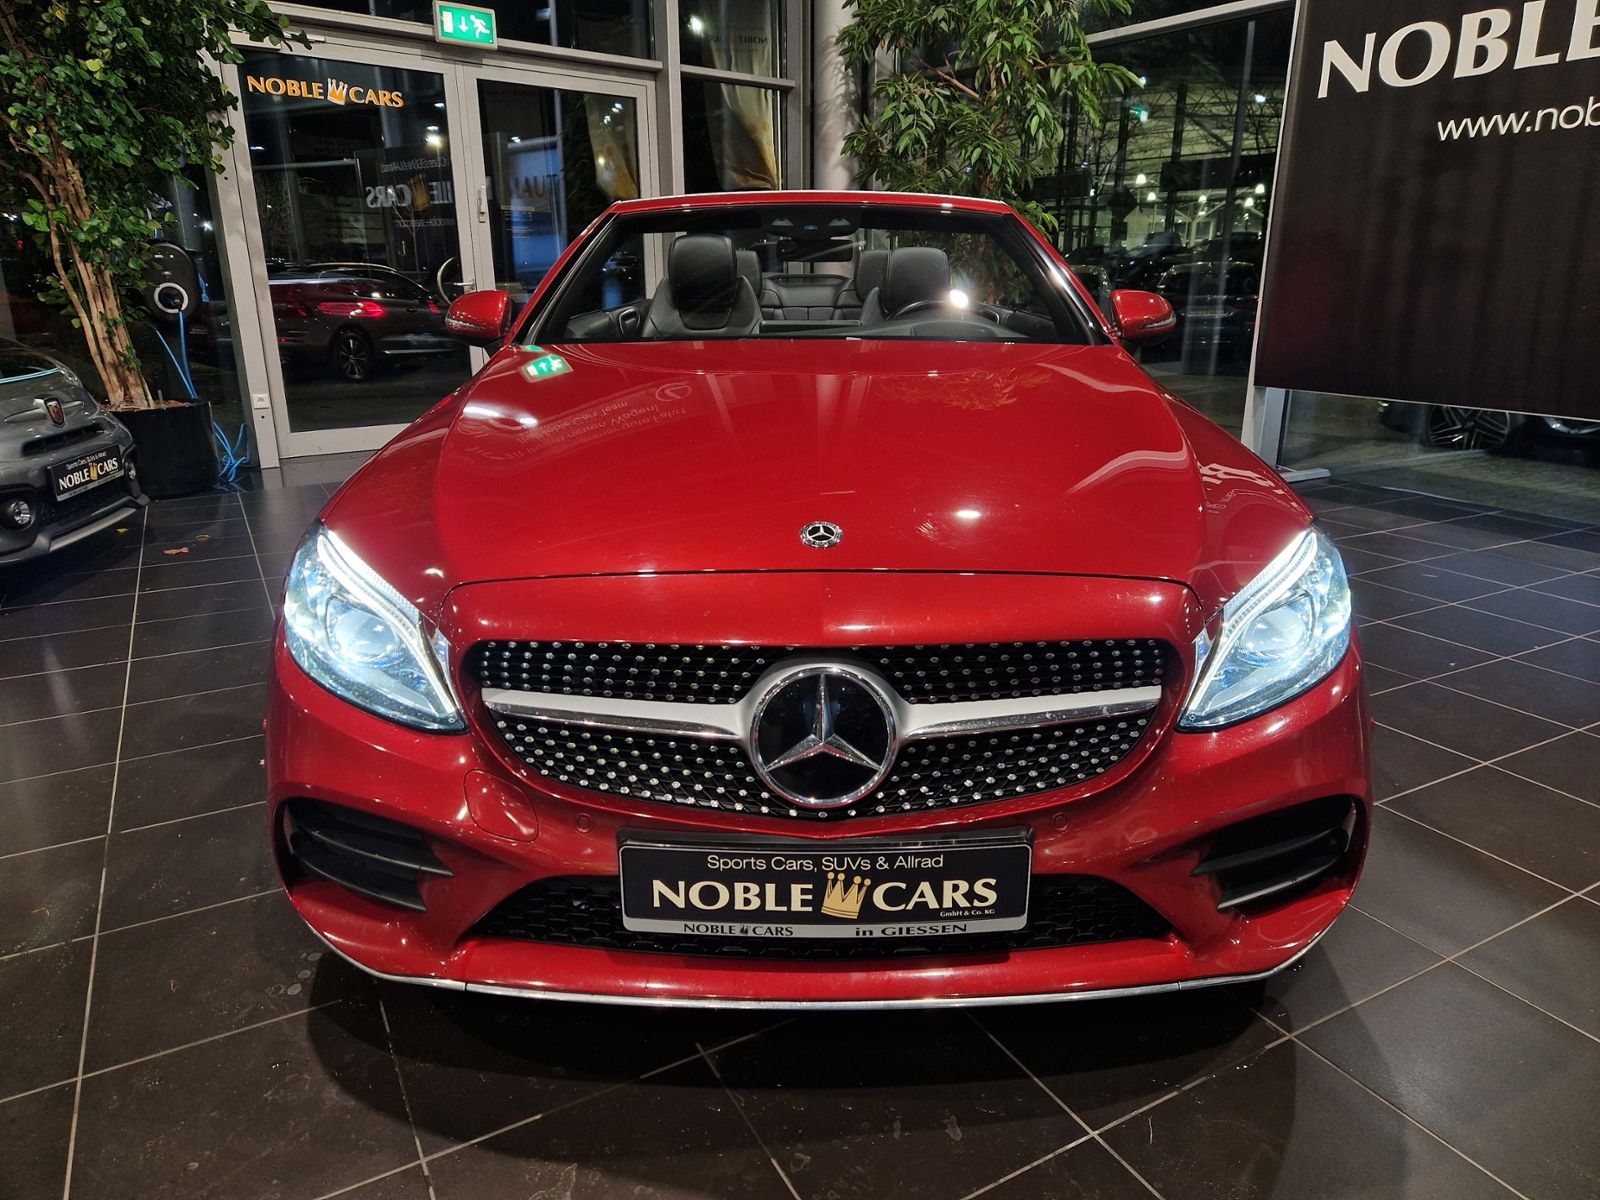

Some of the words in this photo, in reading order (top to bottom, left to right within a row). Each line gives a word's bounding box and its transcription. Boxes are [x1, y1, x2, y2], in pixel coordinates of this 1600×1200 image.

[246, 75, 325, 100] NOBLE
[349, 86, 405, 108] CARS
[58, 468, 90, 490] NOBLE
[97, 457, 119, 475] CARS
[707, 855, 766, 871] Sports
[771, 856, 818, 873] Cars,
[821, 856, 871, 871] SUVs
[875, 856, 889, 870] &
[894, 854, 944, 869] Allrad
[652, 879, 813, 912] NOBLE
[872, 877, 998, 912] CARS
[683, 923, 736, 935] NOBLE
[752, 926, 794, 936] CARS
[855, 927, 874, 937] in
[881, 924, 967, 936] GIESSEN
